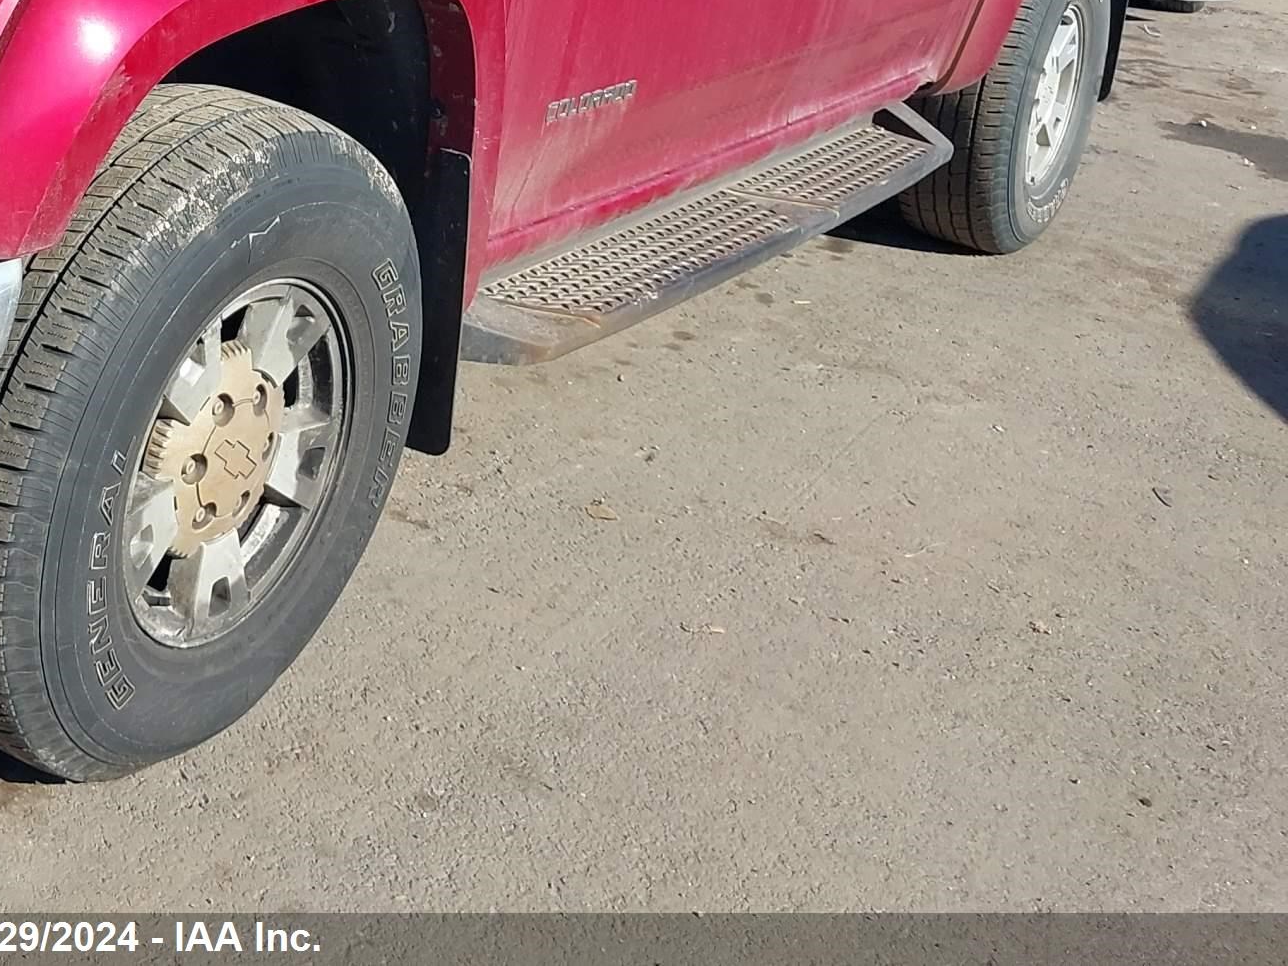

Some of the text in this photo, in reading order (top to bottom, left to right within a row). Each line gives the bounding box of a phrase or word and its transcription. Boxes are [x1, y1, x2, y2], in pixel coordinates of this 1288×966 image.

[545, 79, 638, 124] COLORADO
[368, 257, 412, 509] GRABBER
[88, 444, 136, 711] GENERAL
